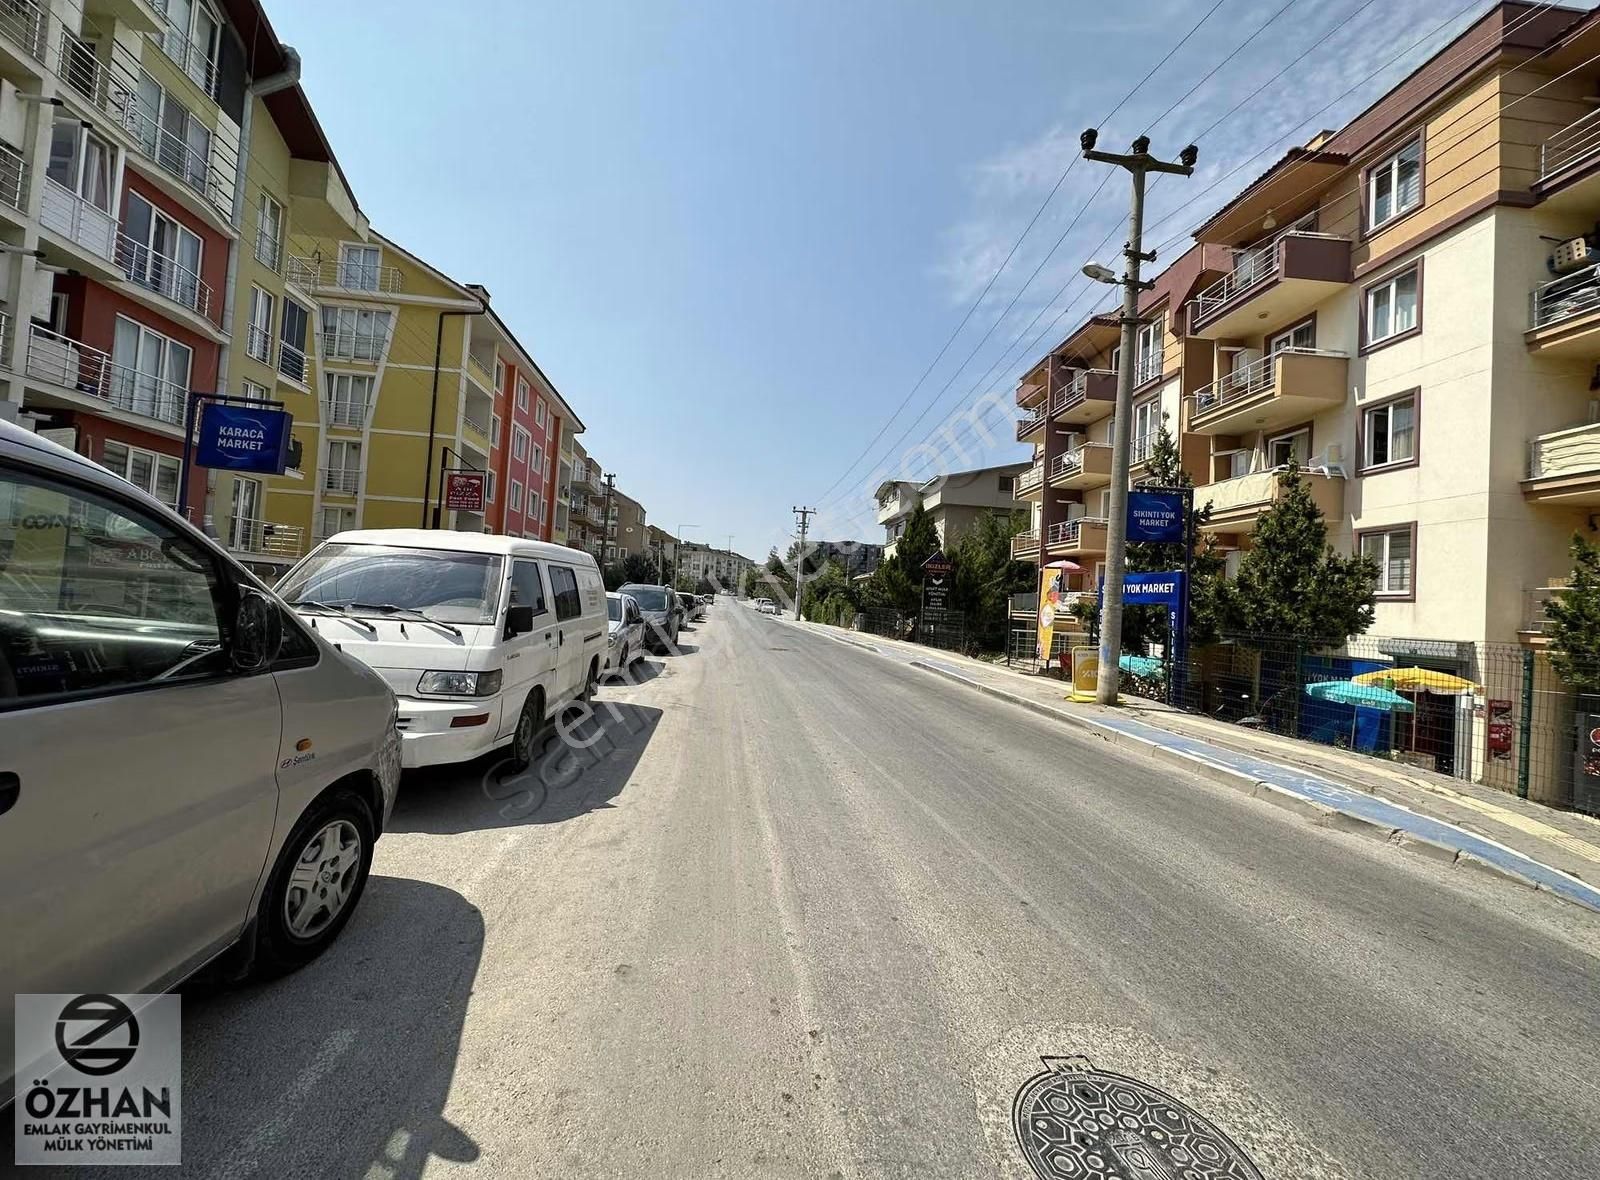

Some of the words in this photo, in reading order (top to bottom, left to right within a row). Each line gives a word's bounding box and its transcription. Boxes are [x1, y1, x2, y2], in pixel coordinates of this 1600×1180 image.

[219, 425, 264, 439] KARACA
[217, 437, 264, 451] MARKET
[1133, 510, 1160, 519] SIKINTI
[1160, 511, 1176, 520] YOK
[1139, 518, 1170, 527] MARKET
[1126, 583, 1141, 594] YOK
[1142, 582, 1175, 594] MARKET
